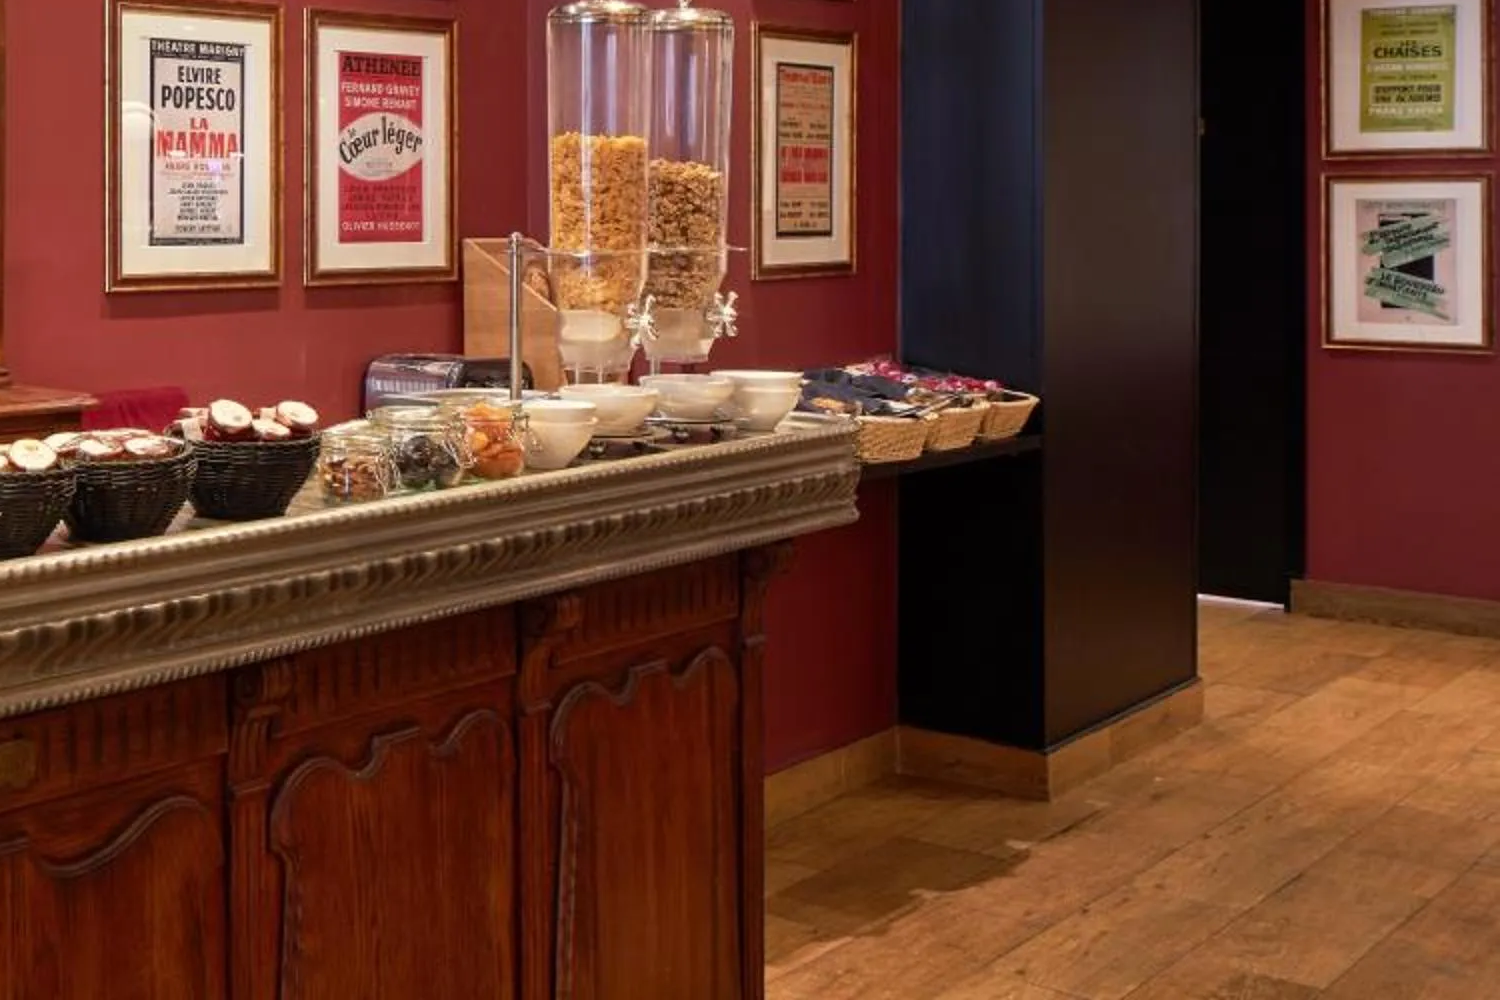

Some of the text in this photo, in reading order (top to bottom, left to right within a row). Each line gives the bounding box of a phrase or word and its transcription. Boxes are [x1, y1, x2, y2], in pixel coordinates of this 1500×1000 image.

[1373, 45, 1443, 59] CHAISES
[177, 65, 222, 85] ELVIRE
[161, 85, 235, 111] POPESCO
[190, 117, 209, 130] LA
[156, 131, 238, 158] MAMMA
[381, 115, 423, 156] léger
